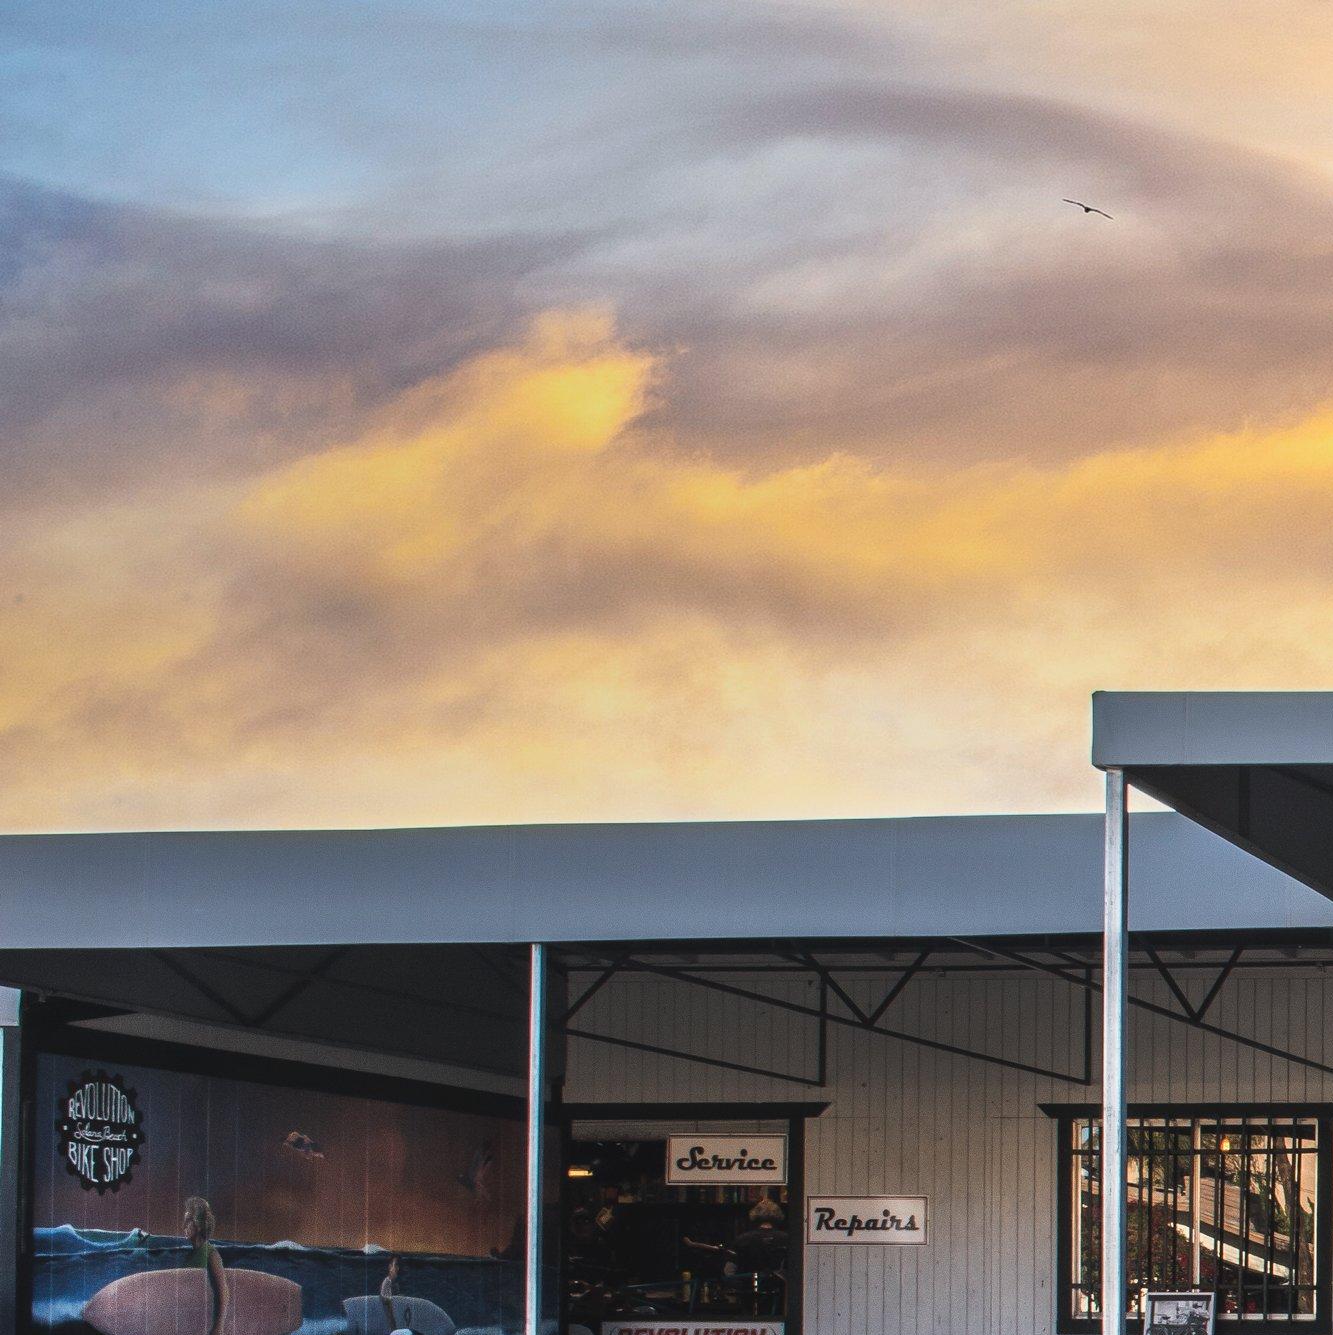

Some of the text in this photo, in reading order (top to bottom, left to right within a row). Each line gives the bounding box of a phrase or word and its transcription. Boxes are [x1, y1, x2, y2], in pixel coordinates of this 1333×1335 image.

[69, 1082, 135, 1124] REVOLUTION
[69, 1141, 134, 1183] BIKE SHOP
[677, 1146, 777, 1171] Service
[815, 1207, 920, 1237] Repairs
